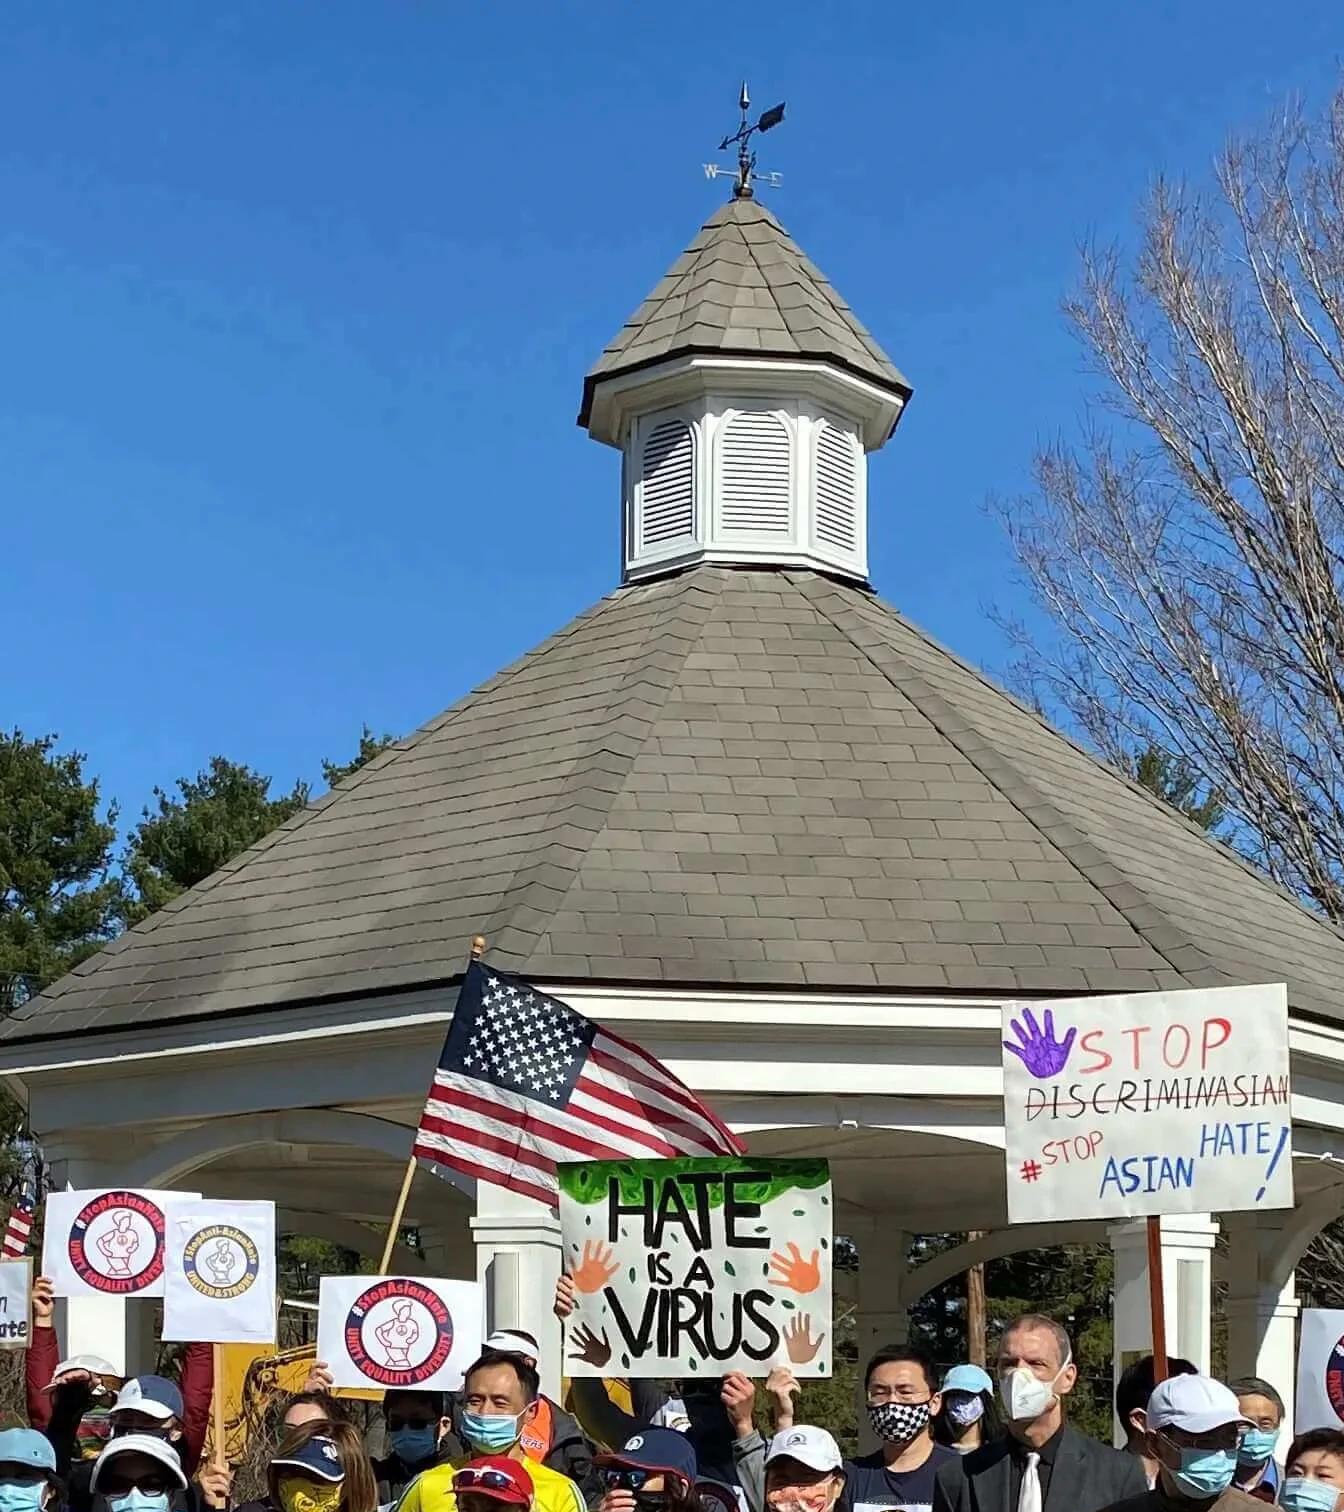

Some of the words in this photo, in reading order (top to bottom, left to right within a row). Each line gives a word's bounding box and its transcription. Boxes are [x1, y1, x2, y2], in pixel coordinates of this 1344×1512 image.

[1079, 1017, 1232, 1074] STOP
[1100, 1157, 1195, 1199] ASIAN
[608, 1171, 773, 1252] HATE
[69, 1239, 86, 1275] UNITY
[83, 1270, 134, 1292] EQUALITY
[647, 1252, 673, 1285] IS
[683, 1255, 715, 1290] A
[351, 1281, 448, 1324] #StopAsianHate
[603, 1286, 780, 1361] VIRUS
[347, 1327, 363, 1361] UNITY
[360, 1360, 413, 1384] EQUALITY
[415, 1331, 453, 1379] DIVERSITY
[1328, 1369, 1344, 1408] UNITY
